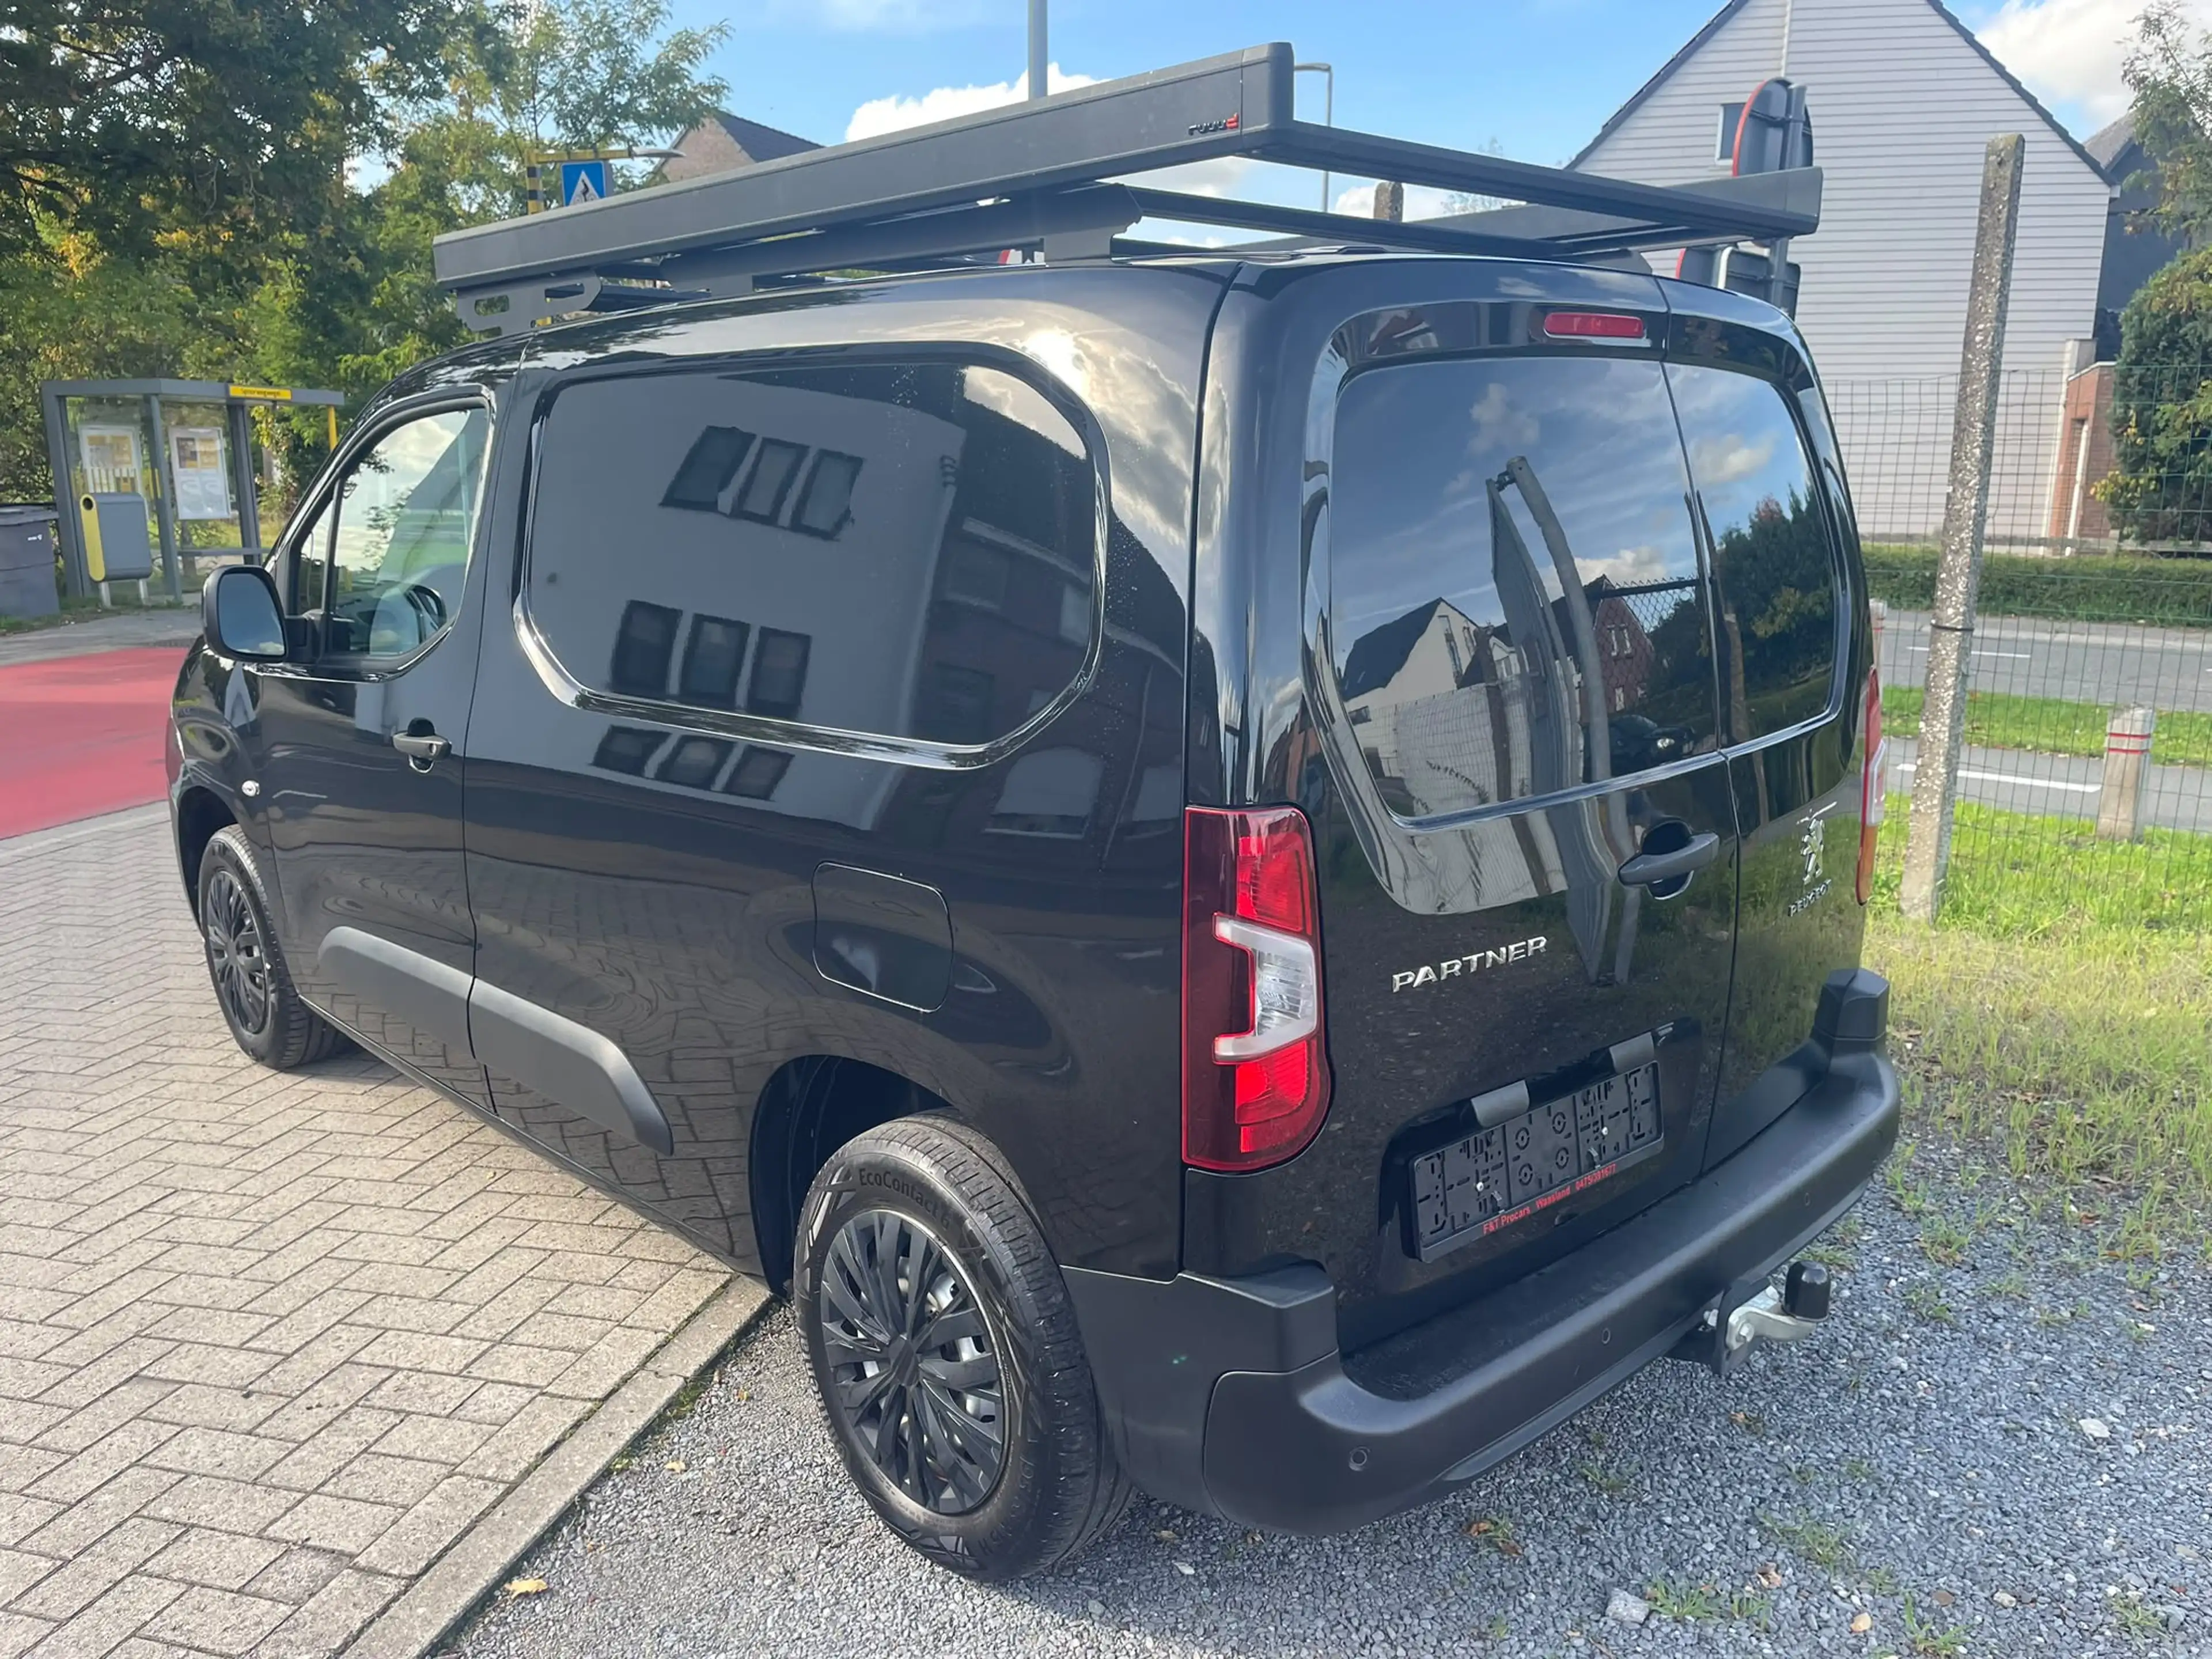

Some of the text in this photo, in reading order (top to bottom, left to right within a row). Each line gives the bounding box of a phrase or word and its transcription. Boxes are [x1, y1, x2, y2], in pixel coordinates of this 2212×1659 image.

[1392, 935, 1548, 993] PARTNER
[859, 1168, 950, 1230] EcoContact 6
[1483, 1218, 1499, 1235] F&T
[1501, 1206, 1531, 1226] Procars
